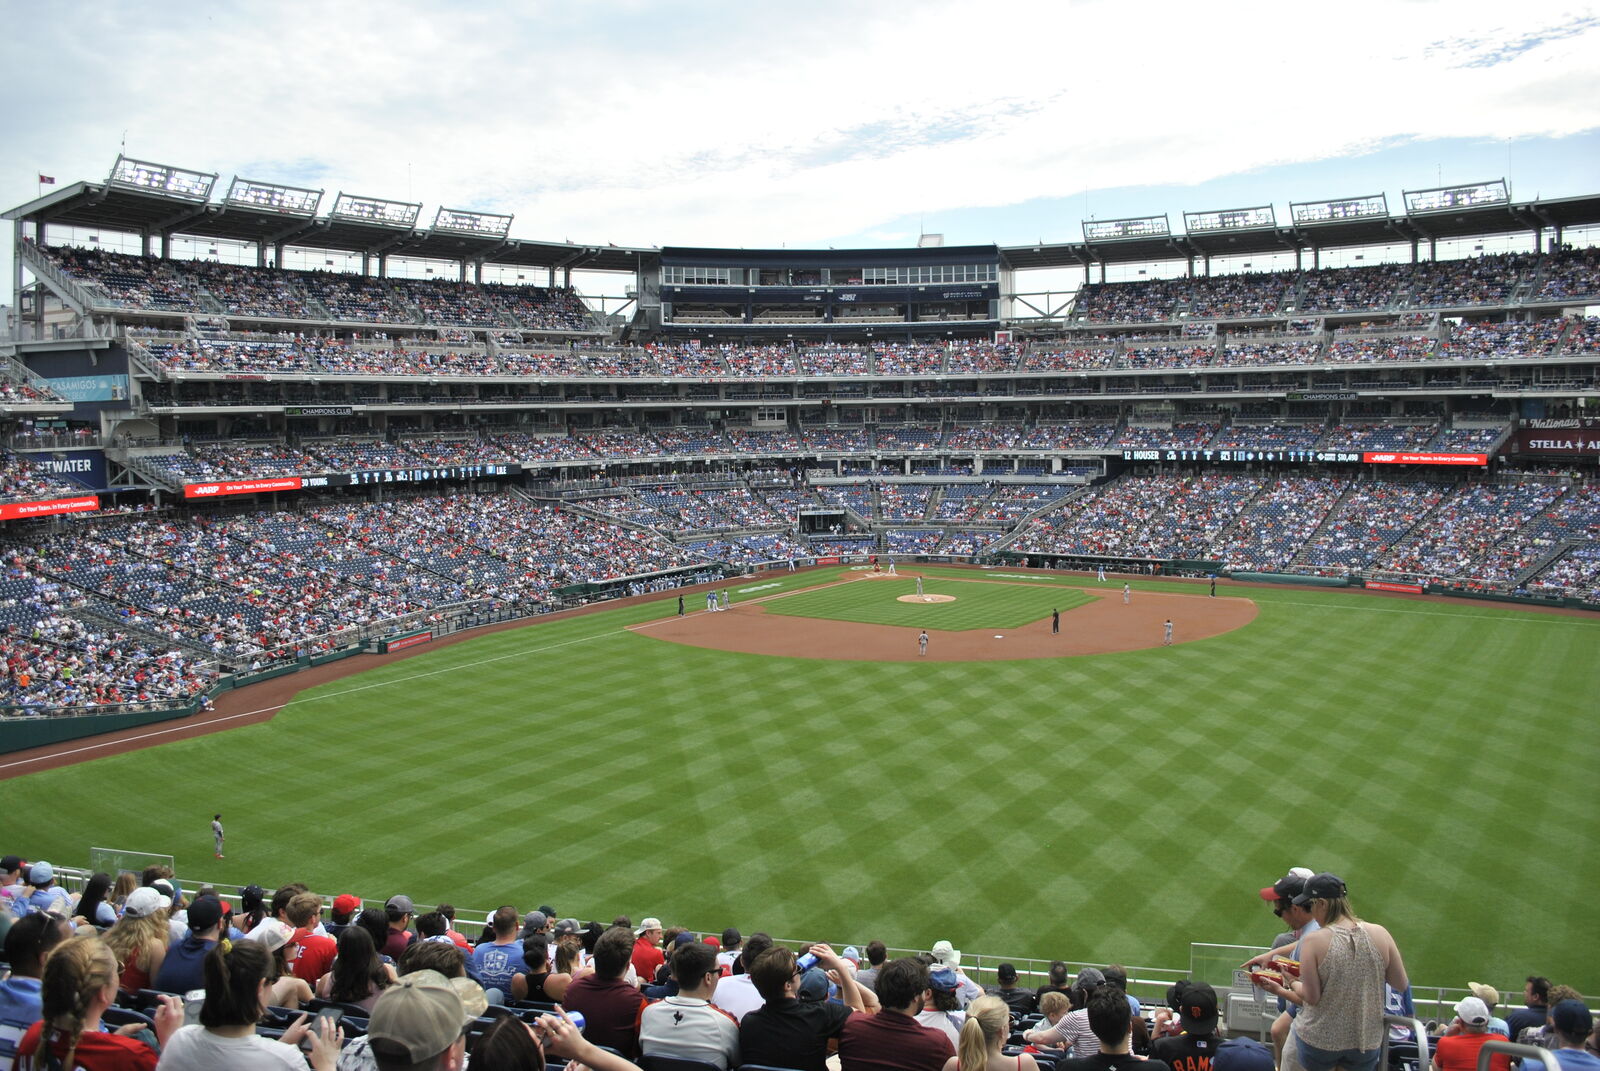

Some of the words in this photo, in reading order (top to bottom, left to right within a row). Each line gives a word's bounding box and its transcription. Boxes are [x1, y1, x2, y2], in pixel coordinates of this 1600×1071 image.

[52, 380, 96, 392] CASAMIGOS
[1529, 419, 1581, 429] Nationals
[1529, 440, 1573, 449] STELLA
[1124, 450, 1131, 460] 12
[1133, 450, 1160, 460] HOUSER
[1258, 451, 1264, 461] 0
[433, 469, 438, 479] 0
[309, 477, 328, 487] YOUNG
[194, 485, 220, 495] AARP
[26, 505, 38, 513] Your
[71, 500, 97, 508] Community.
